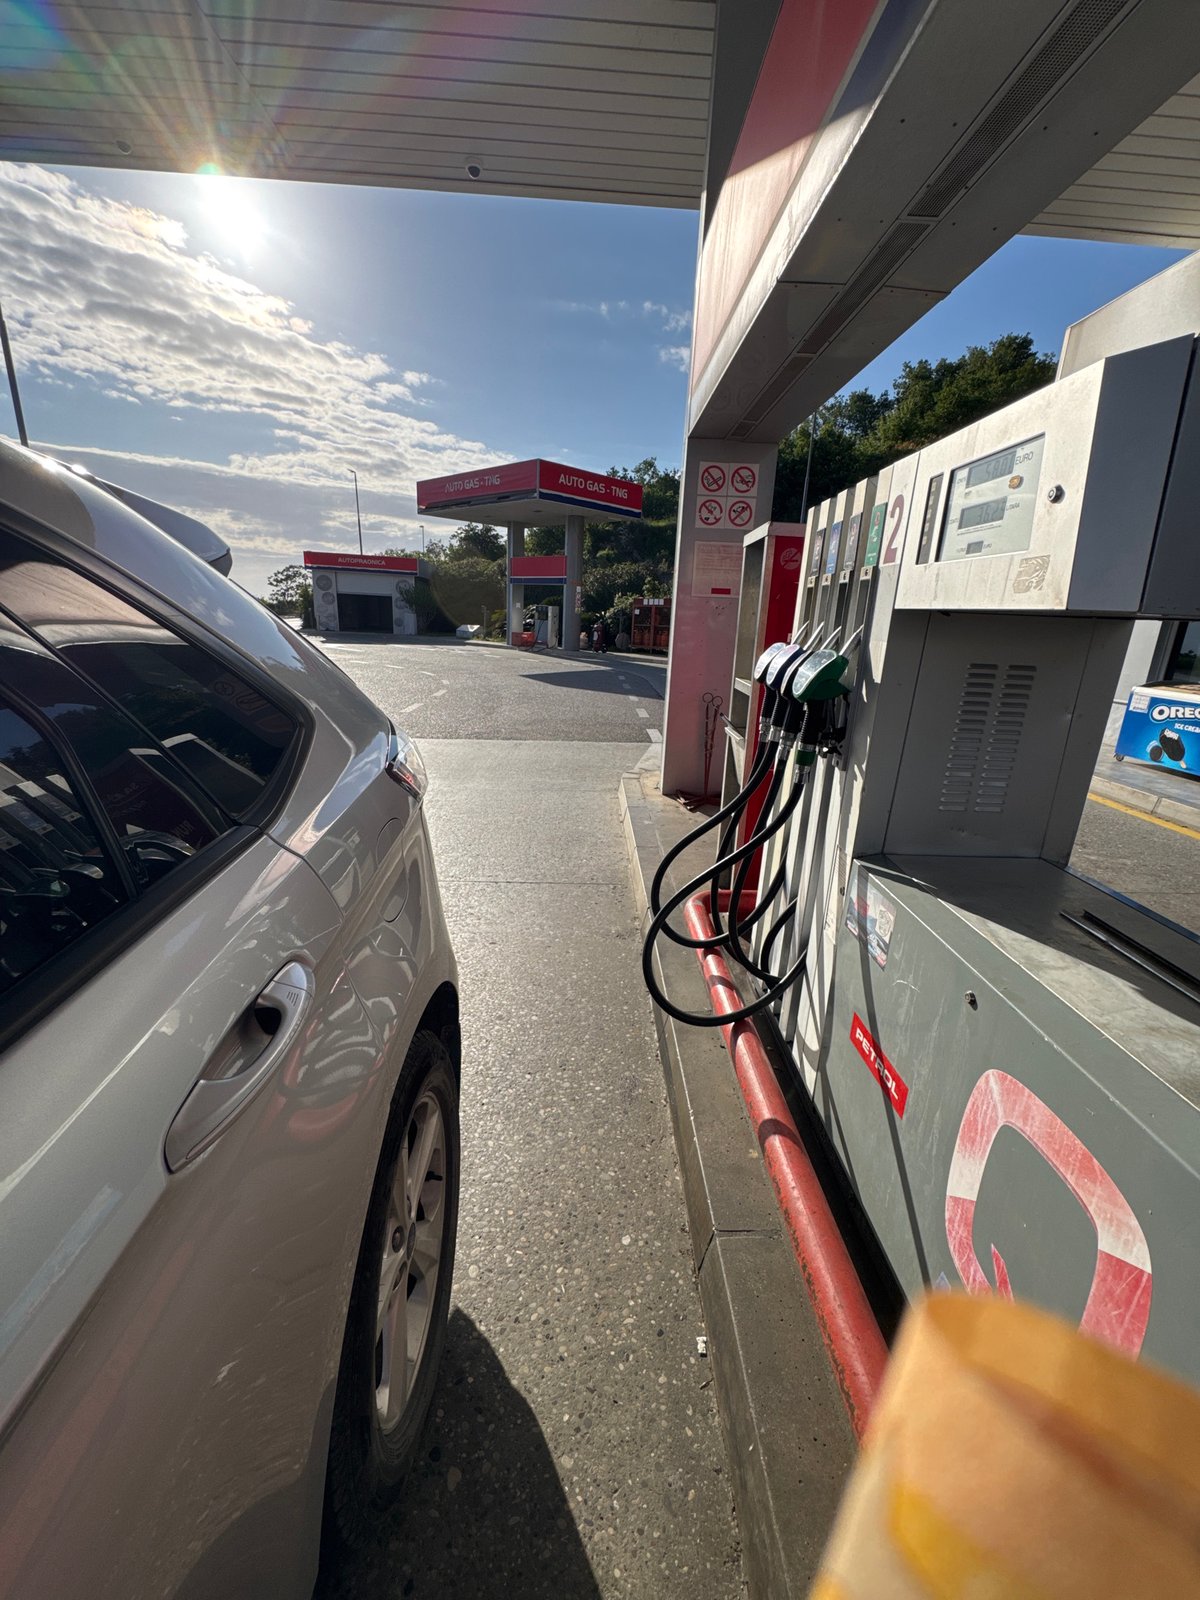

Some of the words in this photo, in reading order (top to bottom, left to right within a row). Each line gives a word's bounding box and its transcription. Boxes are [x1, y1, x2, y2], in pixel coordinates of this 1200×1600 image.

[1015, 451, 1034, 465] EURO
[445, 481, 464, 493] AUTO
[464, 478, 480, 490] GAS
[558, 473, 585, 489] AUTO
[586, 480, 606, 494] GAS
[611, 485, 628, 499] TNG
[882, 493, 905, 565] 2
[855, 1027, 899, 1100] PETROL
